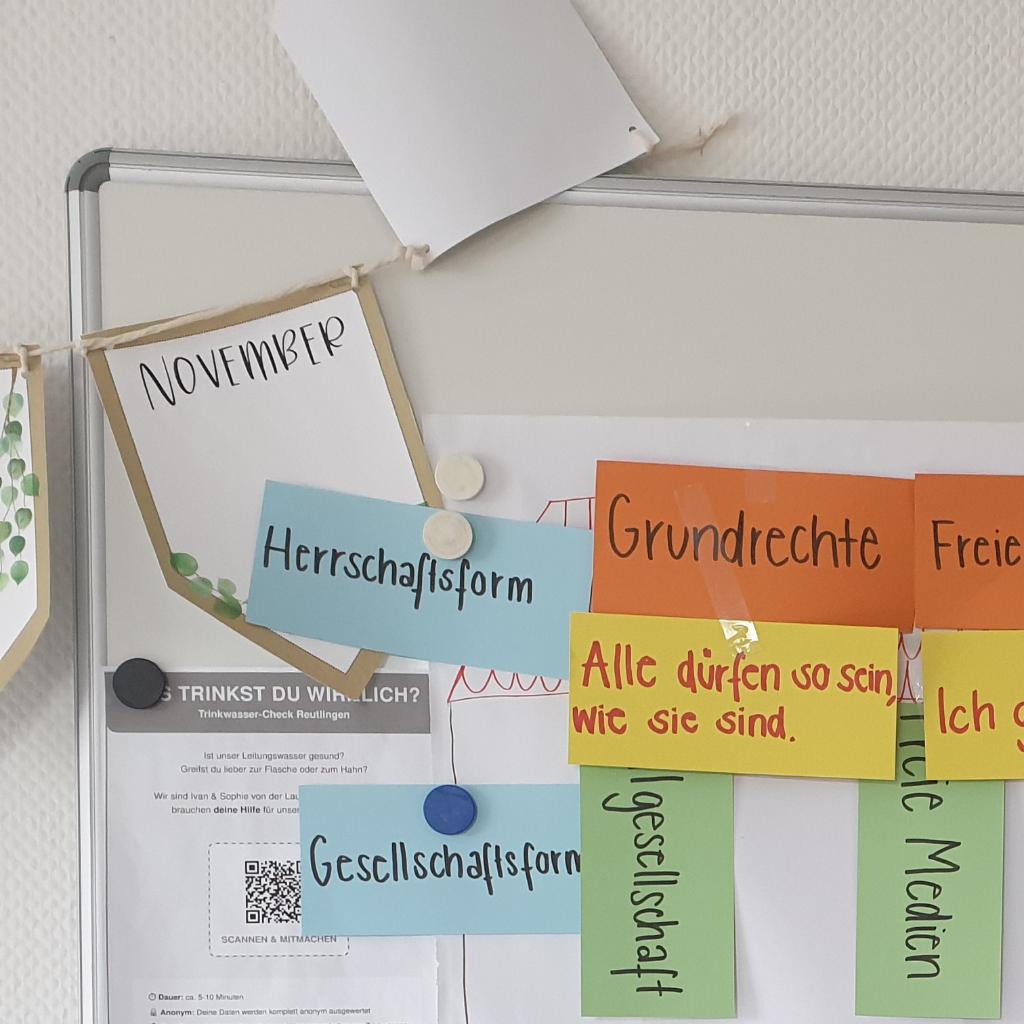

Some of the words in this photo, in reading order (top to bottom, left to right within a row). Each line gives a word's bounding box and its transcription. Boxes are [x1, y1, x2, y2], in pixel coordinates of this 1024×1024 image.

[140, 316, 345, 410] NOVEMBER
[607, 493, 882, 569] Grundrechte
[933, 519, 1021, 569] Freie
[263, 525, 533, 610] Herrschaftsform
[178, 686, 265, 702] TRINKST
[272, 686, 300, 702] DU
[307, 686, 420, 702] WIRLICH?
[582, 640, 657, 689] Alle
[677, 648, 781, 702] dürfen
[791, 663, 830, 691] so
[836, 663, 897, 707] sein,
[198, 709, 293, 719] Trinkwasser-Check
[297, 709, 350, 721] Reutlingen
[572, 704, 627, 734] wie
[648, 707, 699, 734] sie
[715, 706, 795, 742] sind.
[939, 687, 996, 735] Ich
[204, 752, 214, 760] Ist
[242, 752, 305, 762] Leitungswasser
[309, 752, 344, 763] gesund?
[601, 767, 684, 997] lgesellschaft
[905, 838, 961, 980] Medien
[221, 935, 268, 944] SCANNEN
[271, 935, 277, 944] &
[280, 935, 337, 944] MITMACHEN
